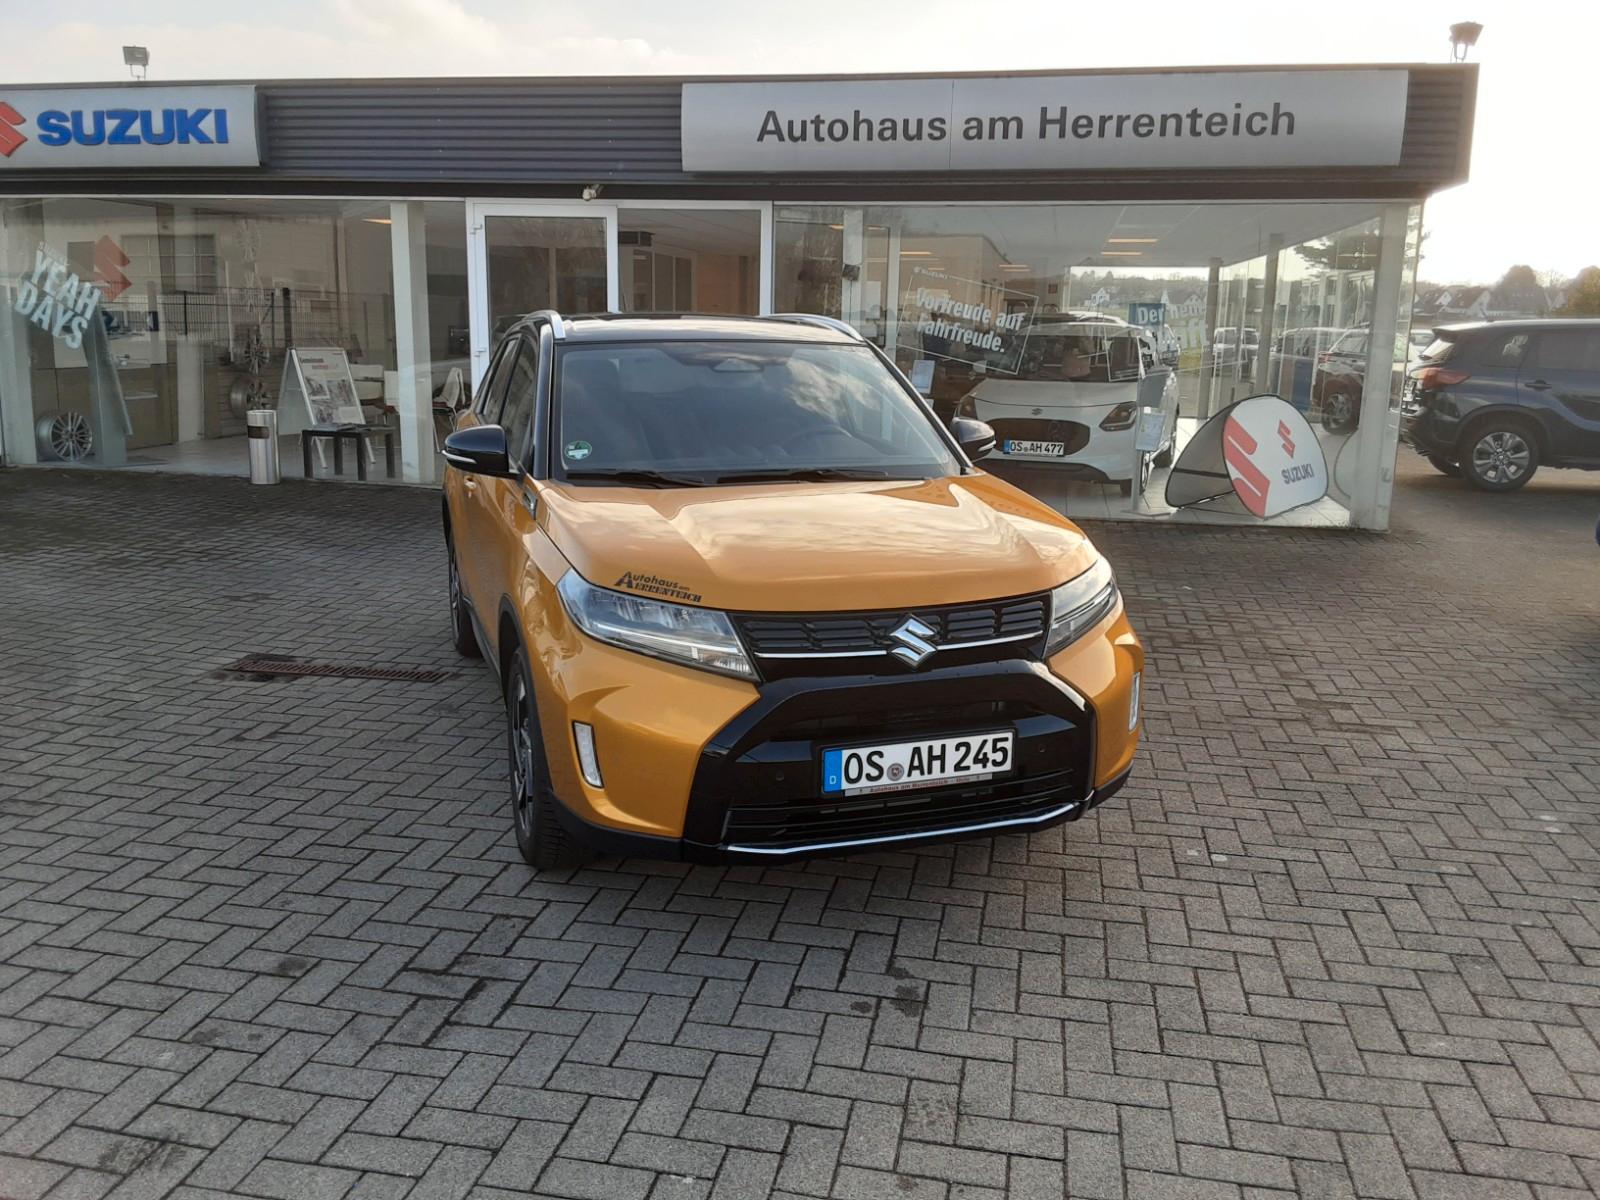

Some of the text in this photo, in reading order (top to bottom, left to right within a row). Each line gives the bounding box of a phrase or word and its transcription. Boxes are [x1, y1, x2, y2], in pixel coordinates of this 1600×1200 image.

[37, 108, 229, 146] SUZUKI
[756, 102, 1295, 143] Autohaus am Herrenteich
[31, 249, 101, 321] YEAH
[14, 280, 88, 349] DAYS
[1137, 306, 1165, 325] Der
[1010, 441, 1063, 454] OS AH 477
[1281, 463, 1315, 485] SUZUKI
[614, 571, 679, 589] Autohaus
[843, 736, 1009, 785] OS AH 245
[829, 774, 837, 785] D
